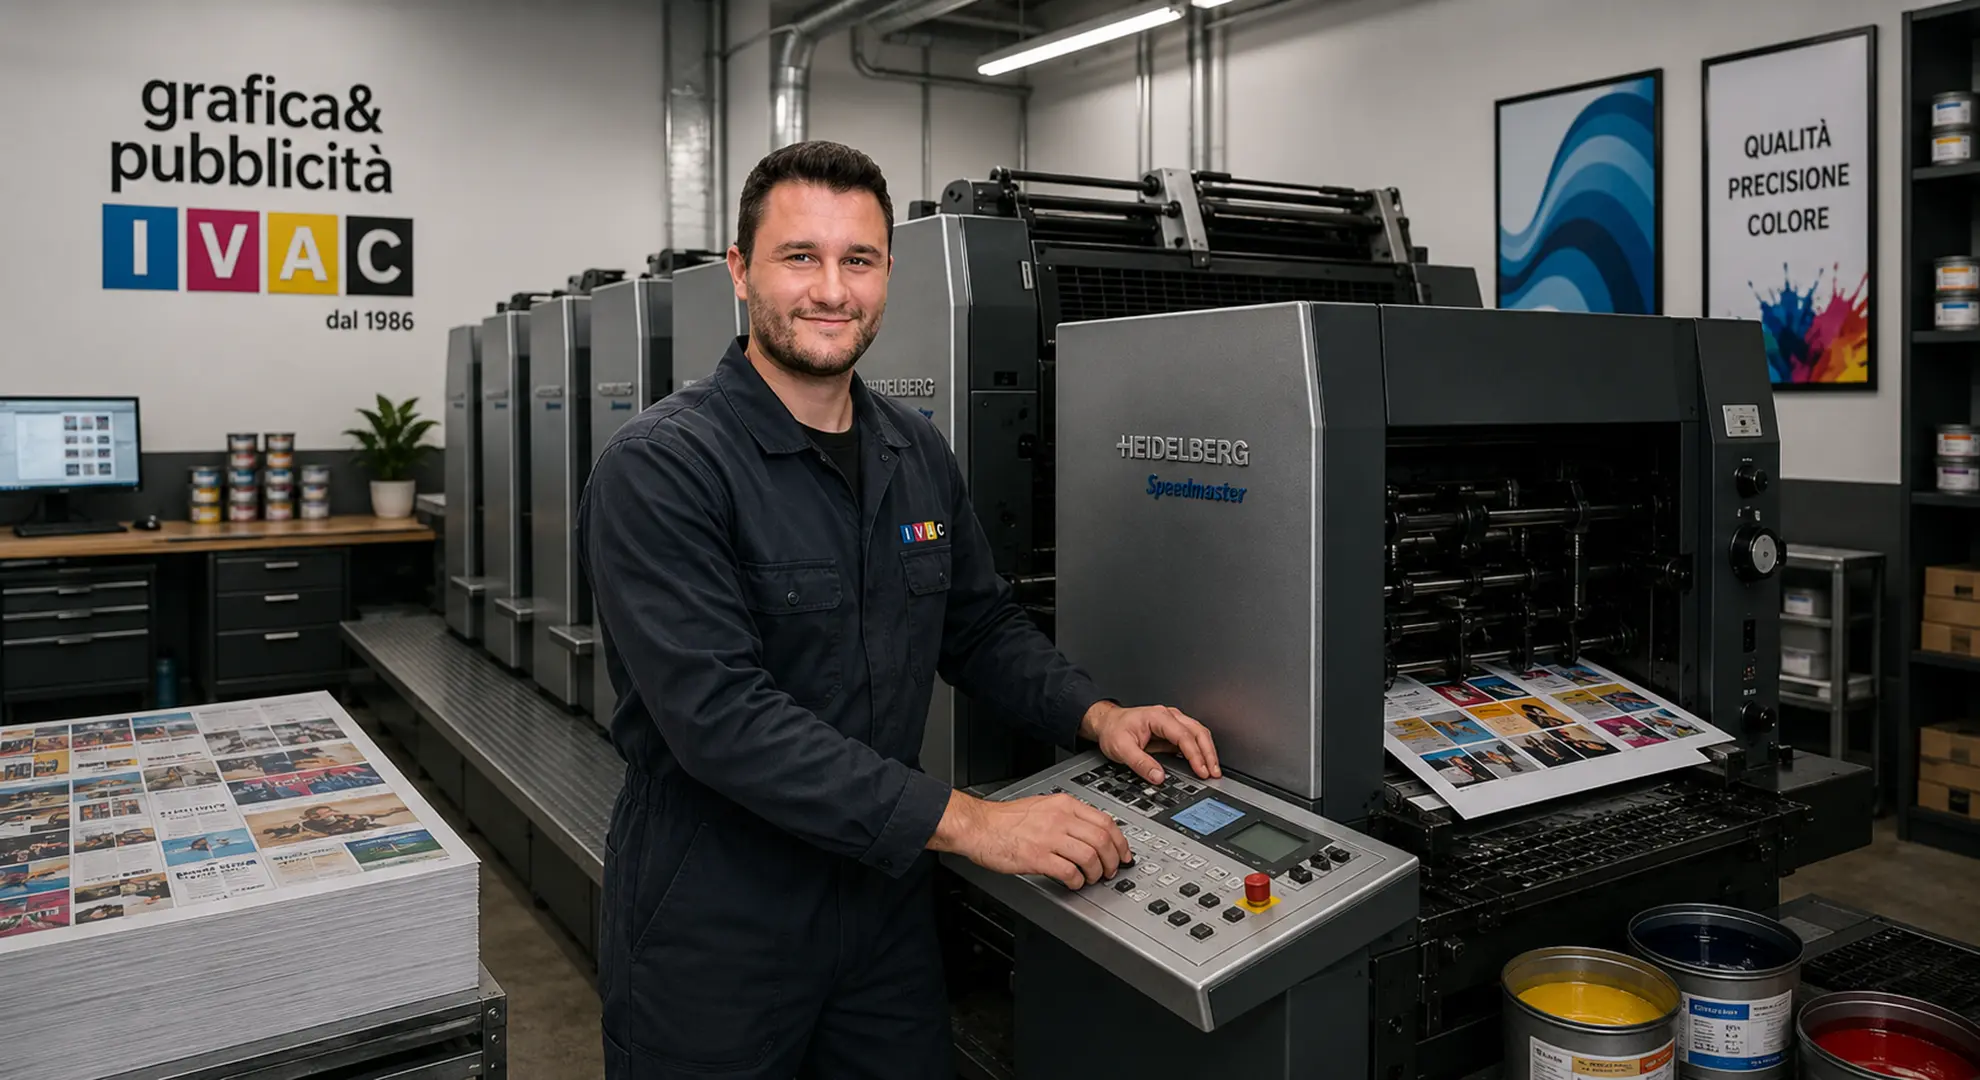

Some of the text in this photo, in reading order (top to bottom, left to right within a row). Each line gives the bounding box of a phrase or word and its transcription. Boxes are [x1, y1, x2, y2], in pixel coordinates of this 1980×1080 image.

[142, 73, 383, 134] grafica&
[1744, 118, 1832, 159] QUALITÀ
[111, 131, 392, 193] pubblicità
[1728, 162, 1850, 200] PRECISIONE
[1747, 206, 1830, 236] COLORE
[131, 217, 403, 285] IVAC
[326, 309, 415, 332] dal 1986
[1116, 434, 1250, 466] HEIDELBERG
[1146, 473, 1248, 504] Speedmaster
